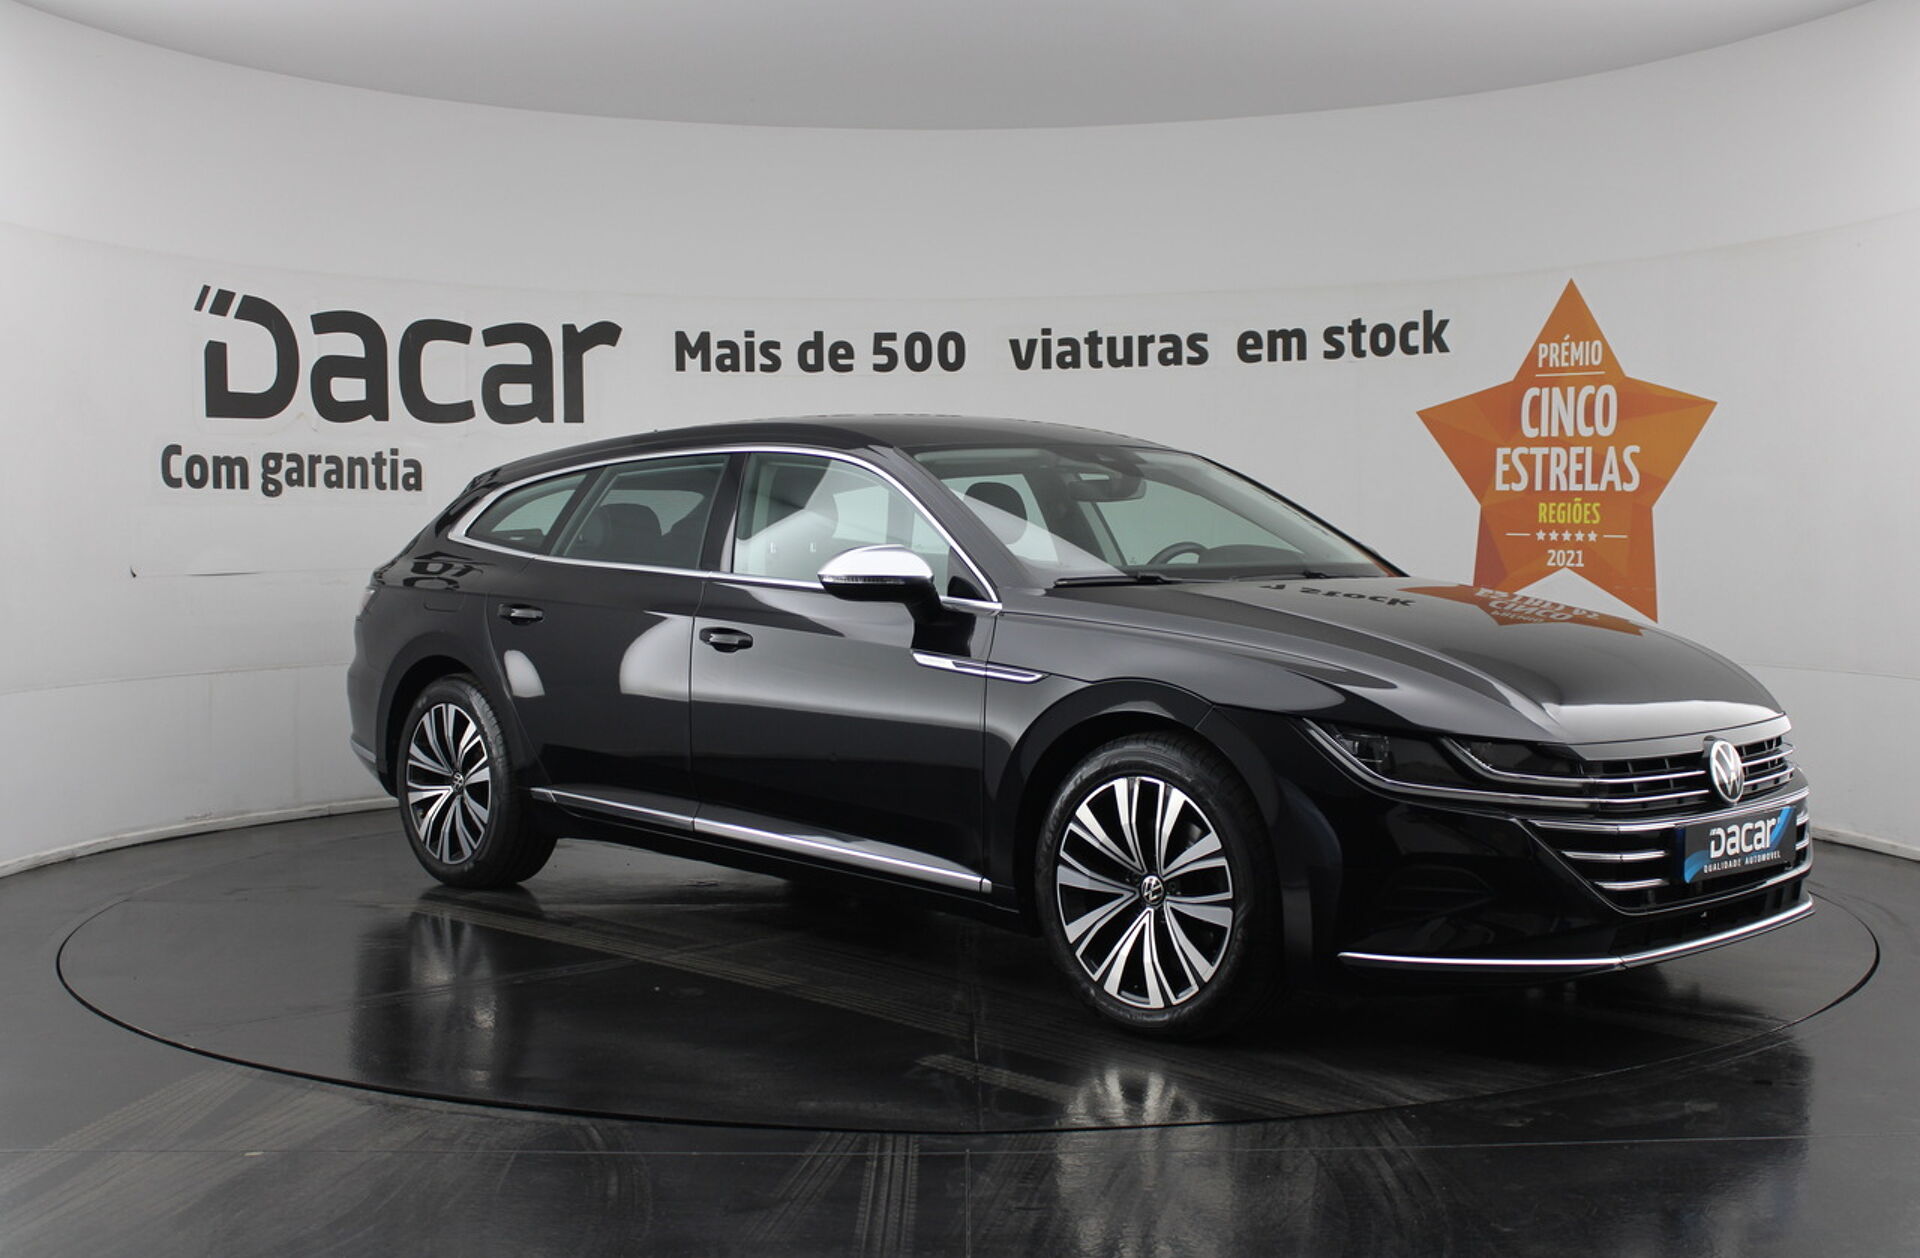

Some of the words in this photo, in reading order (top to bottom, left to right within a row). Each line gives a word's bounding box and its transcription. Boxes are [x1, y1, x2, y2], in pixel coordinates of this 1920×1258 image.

[195, 284, 622, 425] Dacar
[674, 330, 782, 373] Mais
[798, 330, 854, 373] de
[872, 330, 966, 373] 500
[1009, 327, 1209, 370] viaturas
[1236, 328, 1307, 364] em
[1322, 310, 1451, 360] stock
[1538, 334, 1602, 368] PRÉMIO
[1521, 384, 1618, 438] CINCO
[161, 443, 250, 489] Com
[260, 447, 423, 498] garantia
[1495, 445, 1641, 492] ESTRELAS
[1538, 498, 1601, 525] REGIÕES
[1546, 549, 1585, 568] 2021
[1709, 818, 1777, 858] Dacar
